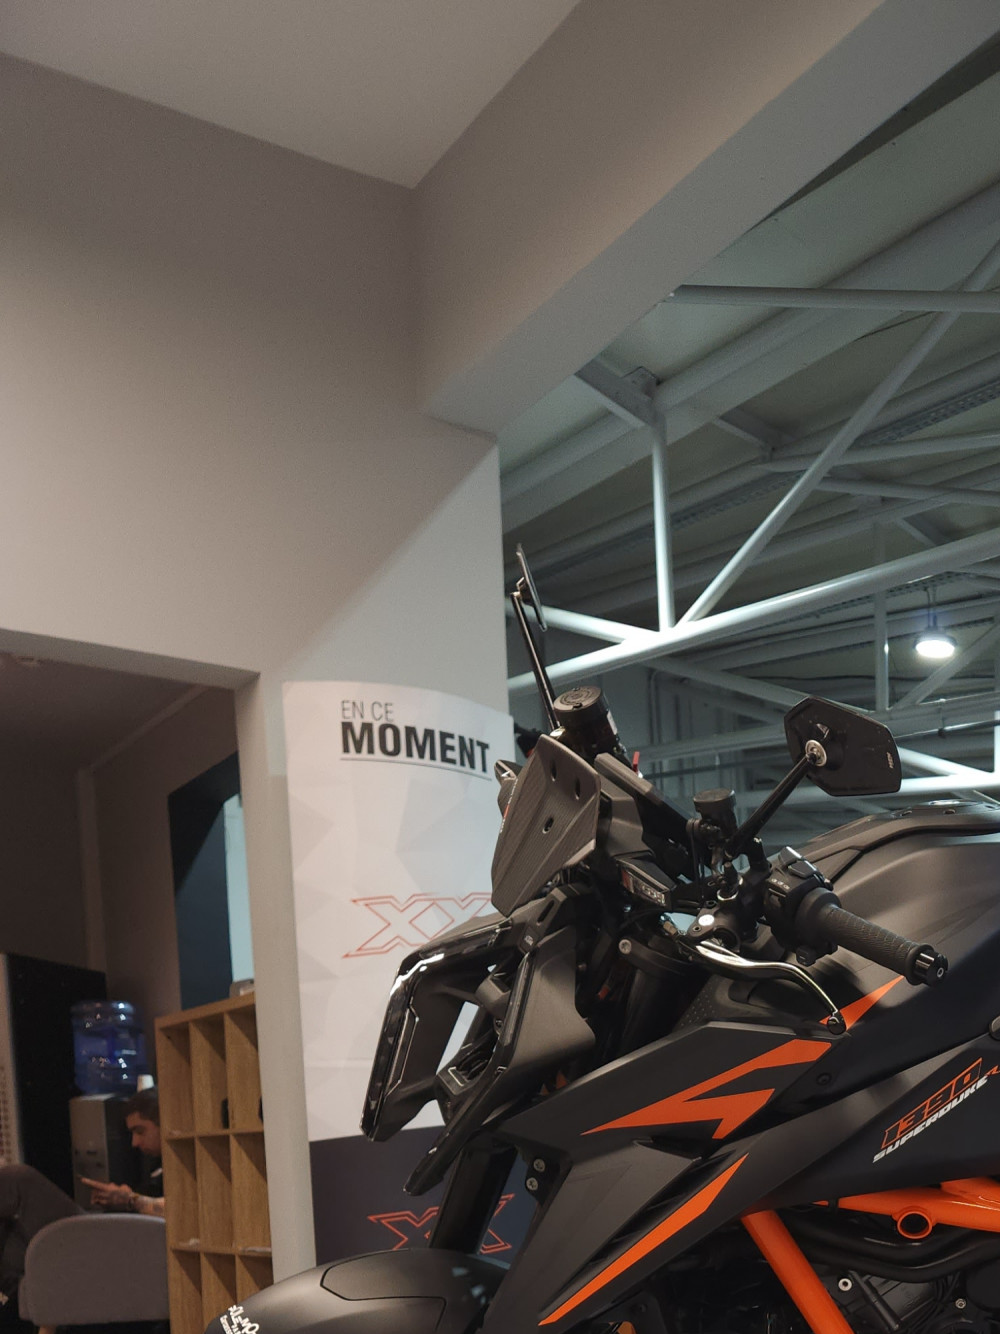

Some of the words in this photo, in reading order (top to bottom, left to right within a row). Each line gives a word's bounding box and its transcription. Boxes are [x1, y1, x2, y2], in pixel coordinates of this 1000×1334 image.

[341, 700, 364, 720] EN
[371, 701, 394, 722] CE
[341, 721, 490, 773] MOMENT
